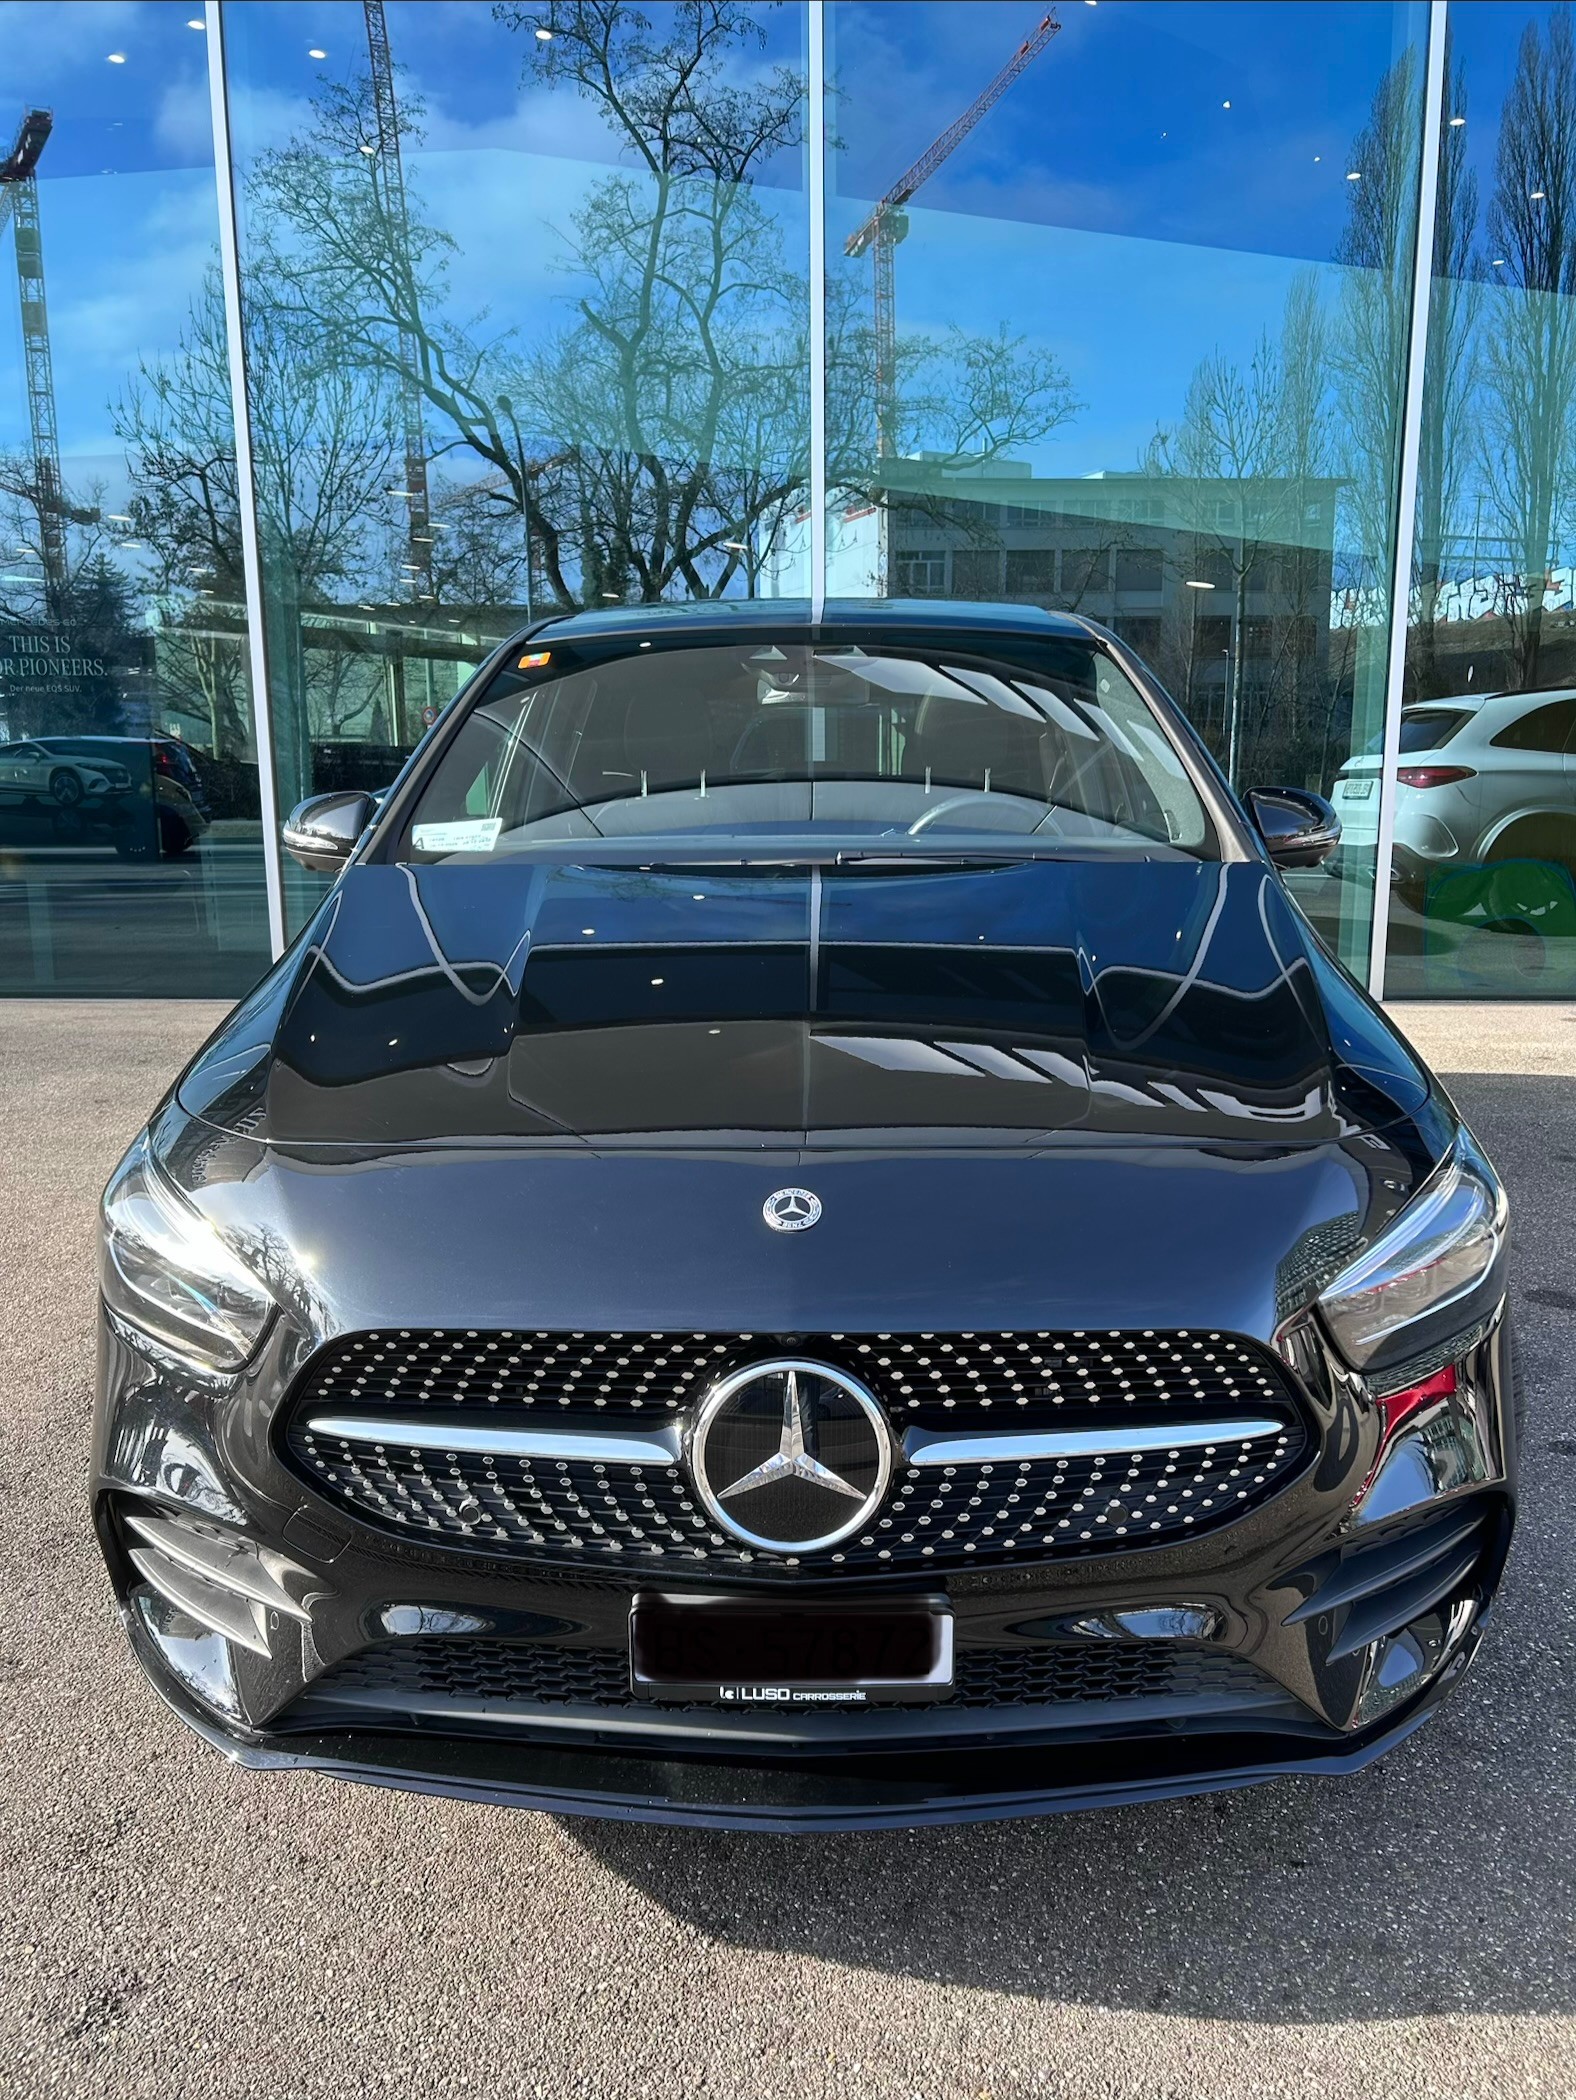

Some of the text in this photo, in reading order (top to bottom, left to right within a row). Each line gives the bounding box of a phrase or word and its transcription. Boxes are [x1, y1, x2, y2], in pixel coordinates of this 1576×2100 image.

[9, 635, 71, 653] THIS IS
[0, 658, 108, 677] R PIONEERS.
[10, 684, 82, 693] Der neue EQS SUV.
[741, 1687, 790, 1700] LUSO
